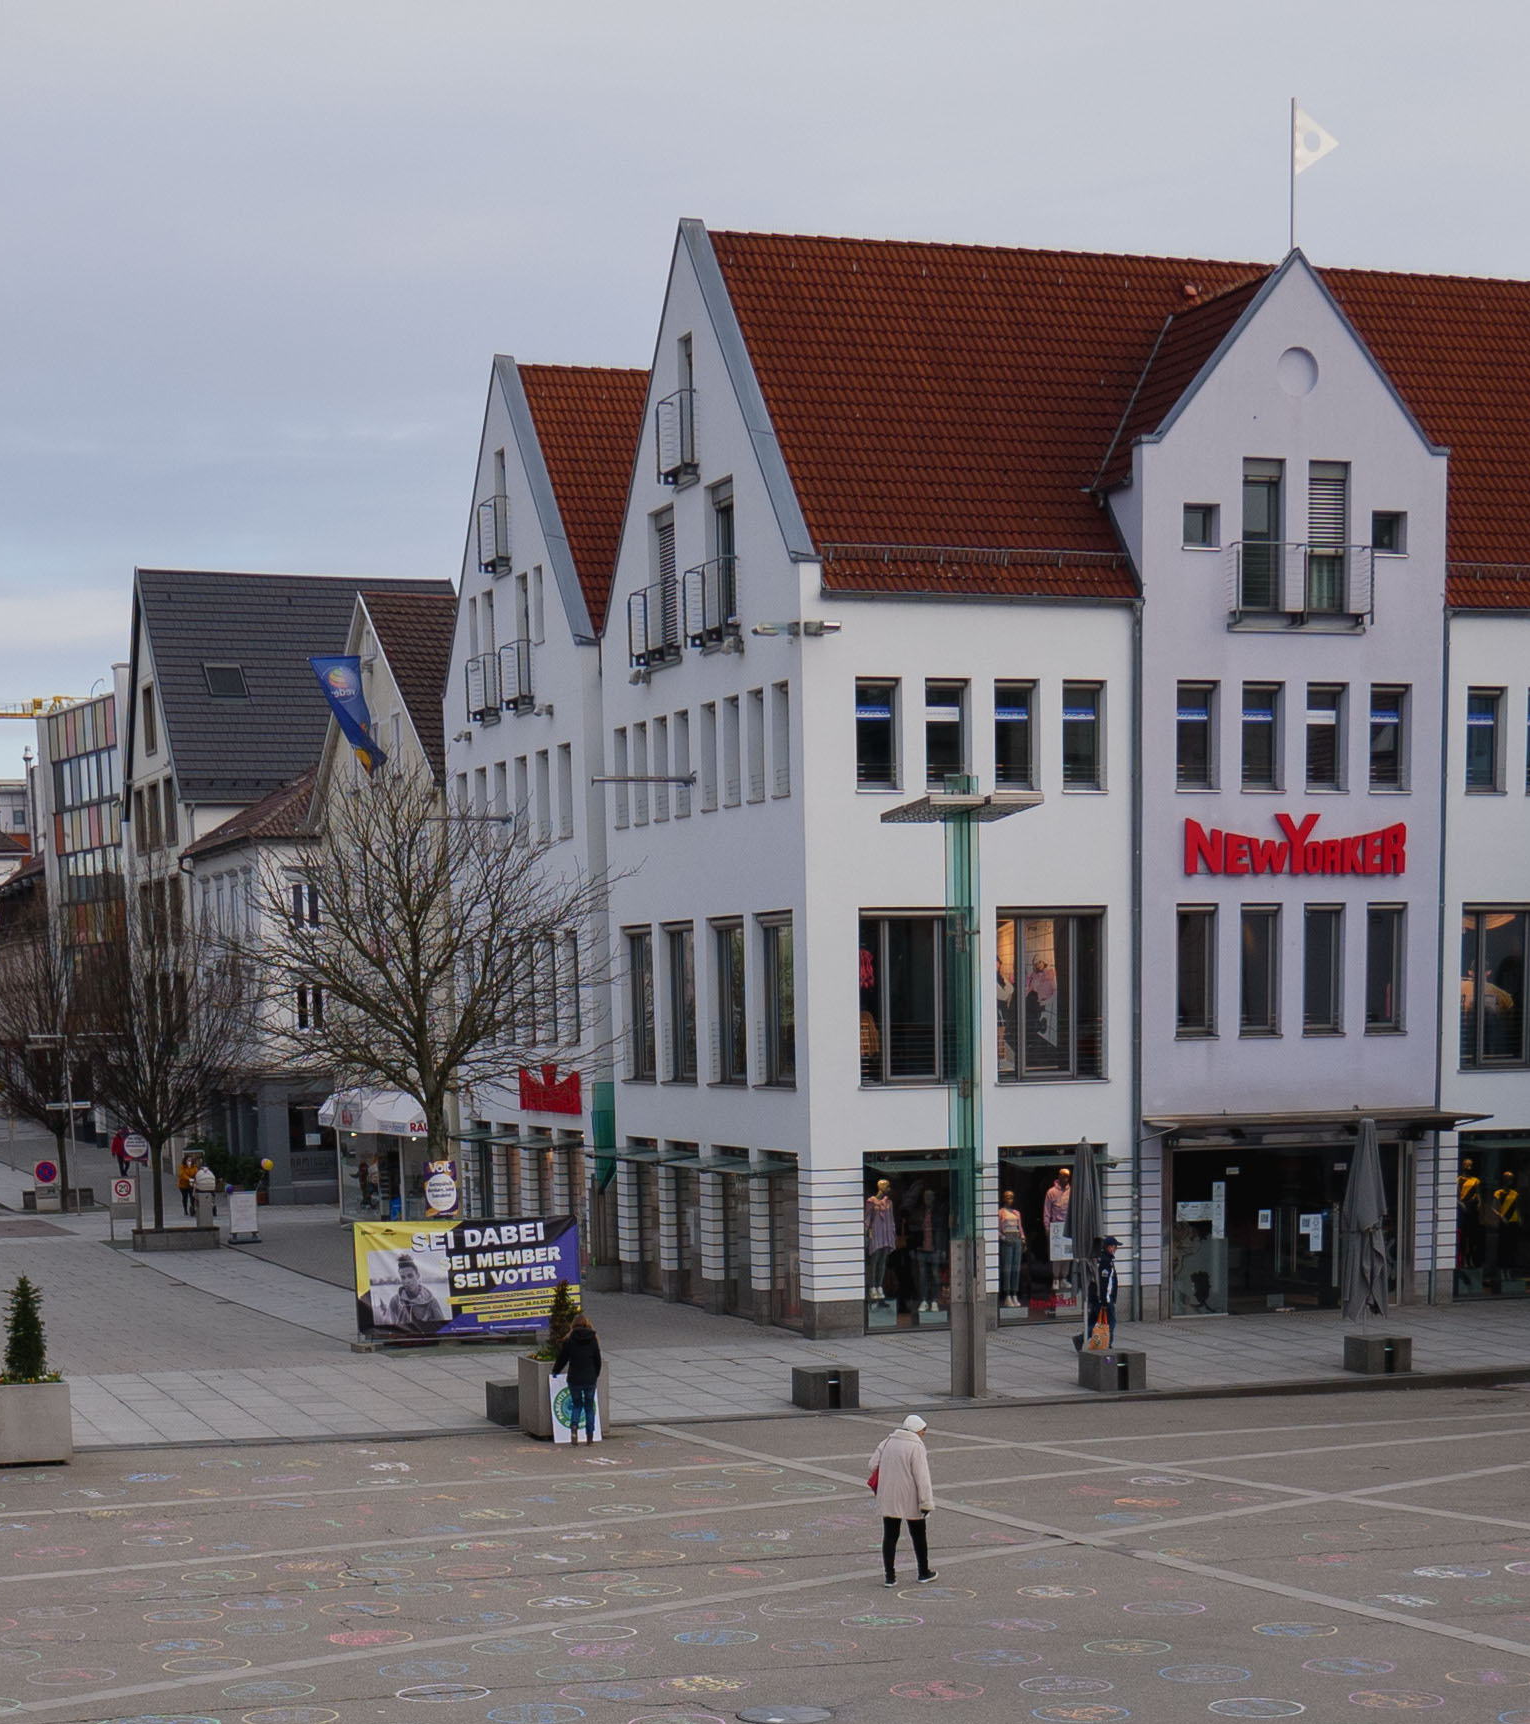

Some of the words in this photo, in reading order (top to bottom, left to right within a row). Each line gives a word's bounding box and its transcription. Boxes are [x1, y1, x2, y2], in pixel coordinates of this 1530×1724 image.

[428, 1162, 452, 1174] Volt
[411, 1230, 456, 1253] SEI
[464, 1221, 545, 1249] DABEI
[438, 1254, 471, 1272] SEI
[476, 1245, 562, 1270] MEMBER
[453, 1273, 486, 1289] SEI
[490, 1265, 558, 1287] VOTER
